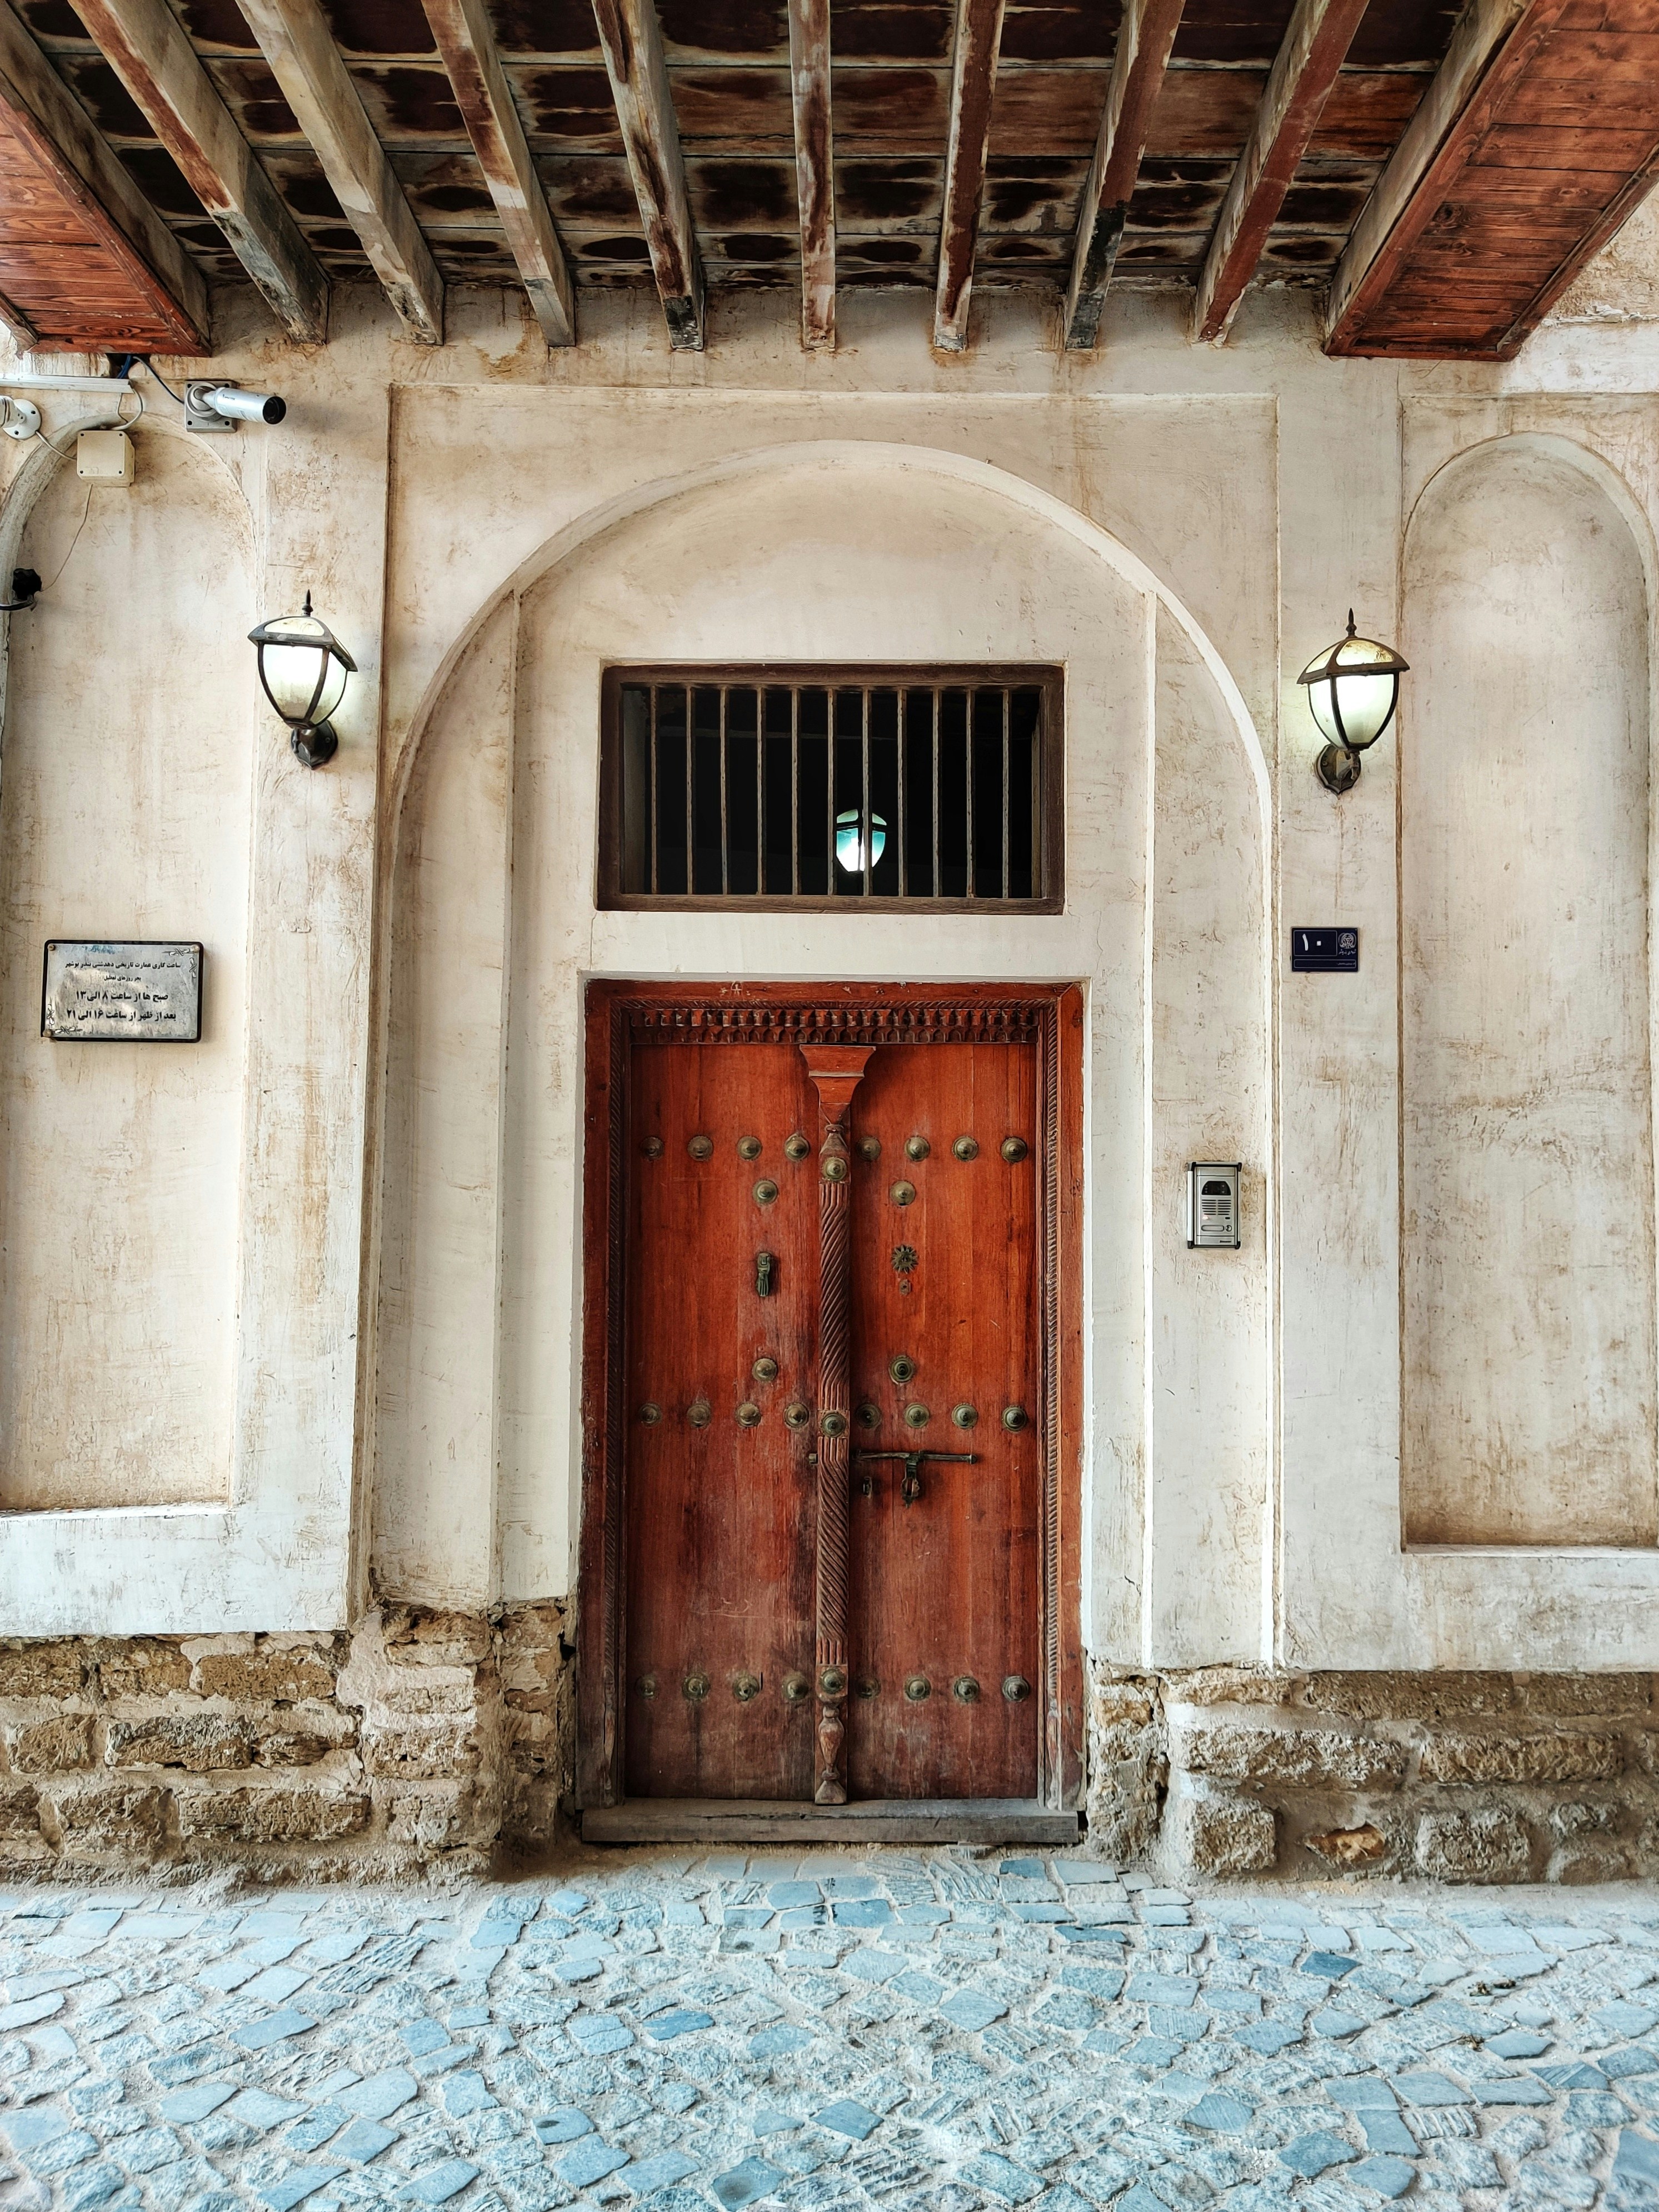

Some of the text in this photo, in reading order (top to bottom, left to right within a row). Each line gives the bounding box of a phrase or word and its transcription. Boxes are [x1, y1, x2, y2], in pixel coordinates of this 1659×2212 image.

[102, 991, 108, 1000] ۸
[111, 991, 132, 1000] ساعت
[133, 992, 141, 1002] از
[143, 992, 151, 1000] ها
[152, 994, 169, 1002] صبح
[66, 1008, 177, 1022] بعد از ظهر از ساعت ۱۶ الی ۲۱
